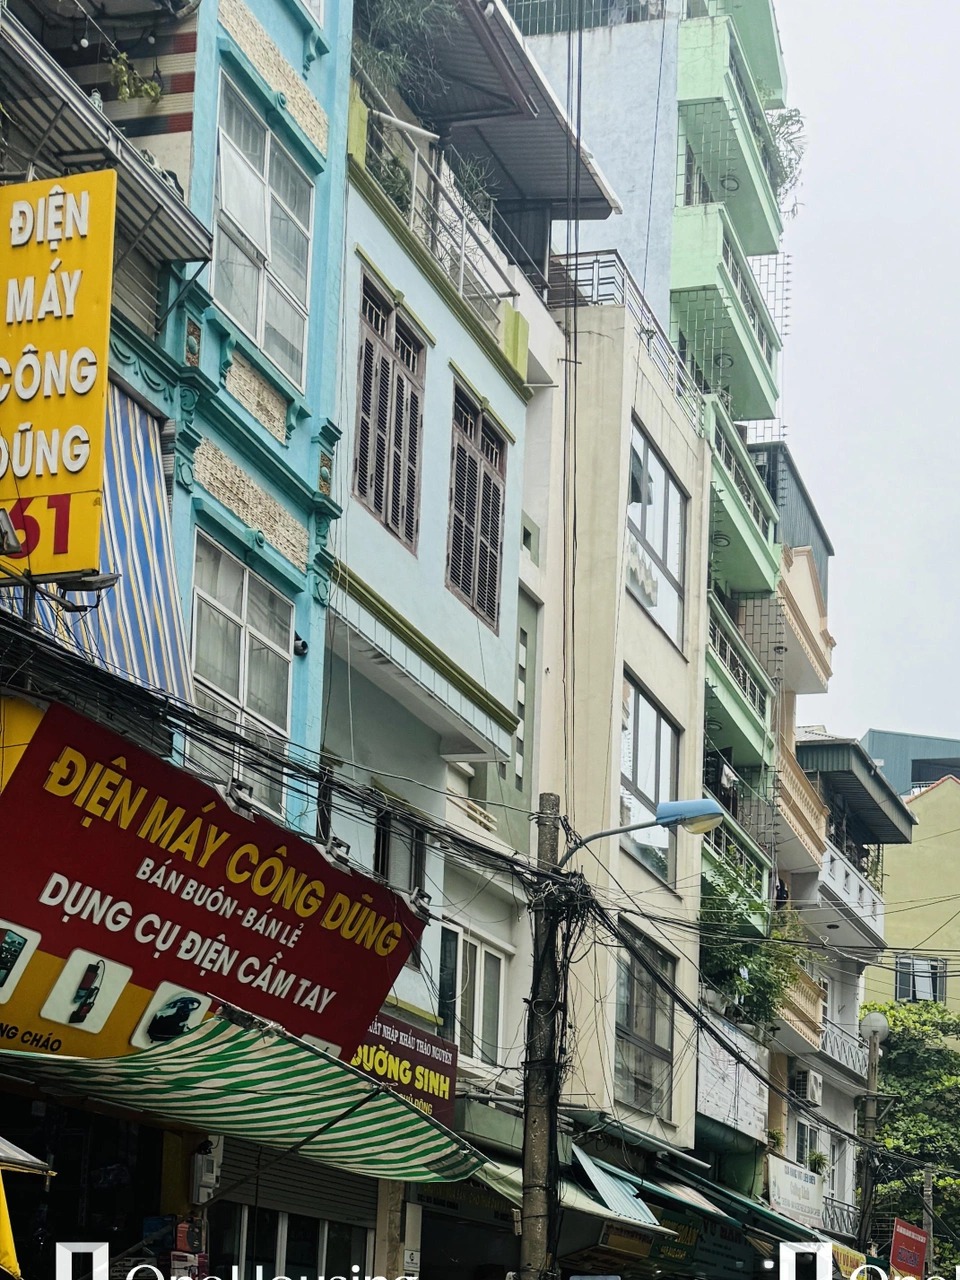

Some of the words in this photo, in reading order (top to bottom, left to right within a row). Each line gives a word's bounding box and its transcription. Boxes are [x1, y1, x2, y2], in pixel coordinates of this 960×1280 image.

[10, 184, 90, 251] ĐIỆN
[6, 258, 83, 324] MÁY
[5, 493, 71, 560] 61
[43, 746, 148, 828] ĐIỆN
[137, 801, 230, 871] MÁY
[226, 843, 327, 919] CÔNG
[321, 892, 402, 957] DŨNG
[136, 857, 181, 896] BÁN
[181, 879, 236, 921] BUÔN
[242, 903, 282, 940] BÁN
[281, 924, 303, 949] LẺ
[39, 872, 132, 932] DỤNG
[134, 912, 180, 959] CỤ
[179, 933, 237, 978] ĐIỆN
[237, 947, 297, 1001] CẦM
[293, 976, 337, 1015] TAY
[21, 1031, 62, 1052] CHÁO
[382, 1025, 399, 1045] NHẬP
[399, 1029, 416, 1050] KHẨU
[415, 1065, 450, 1100] SINH
